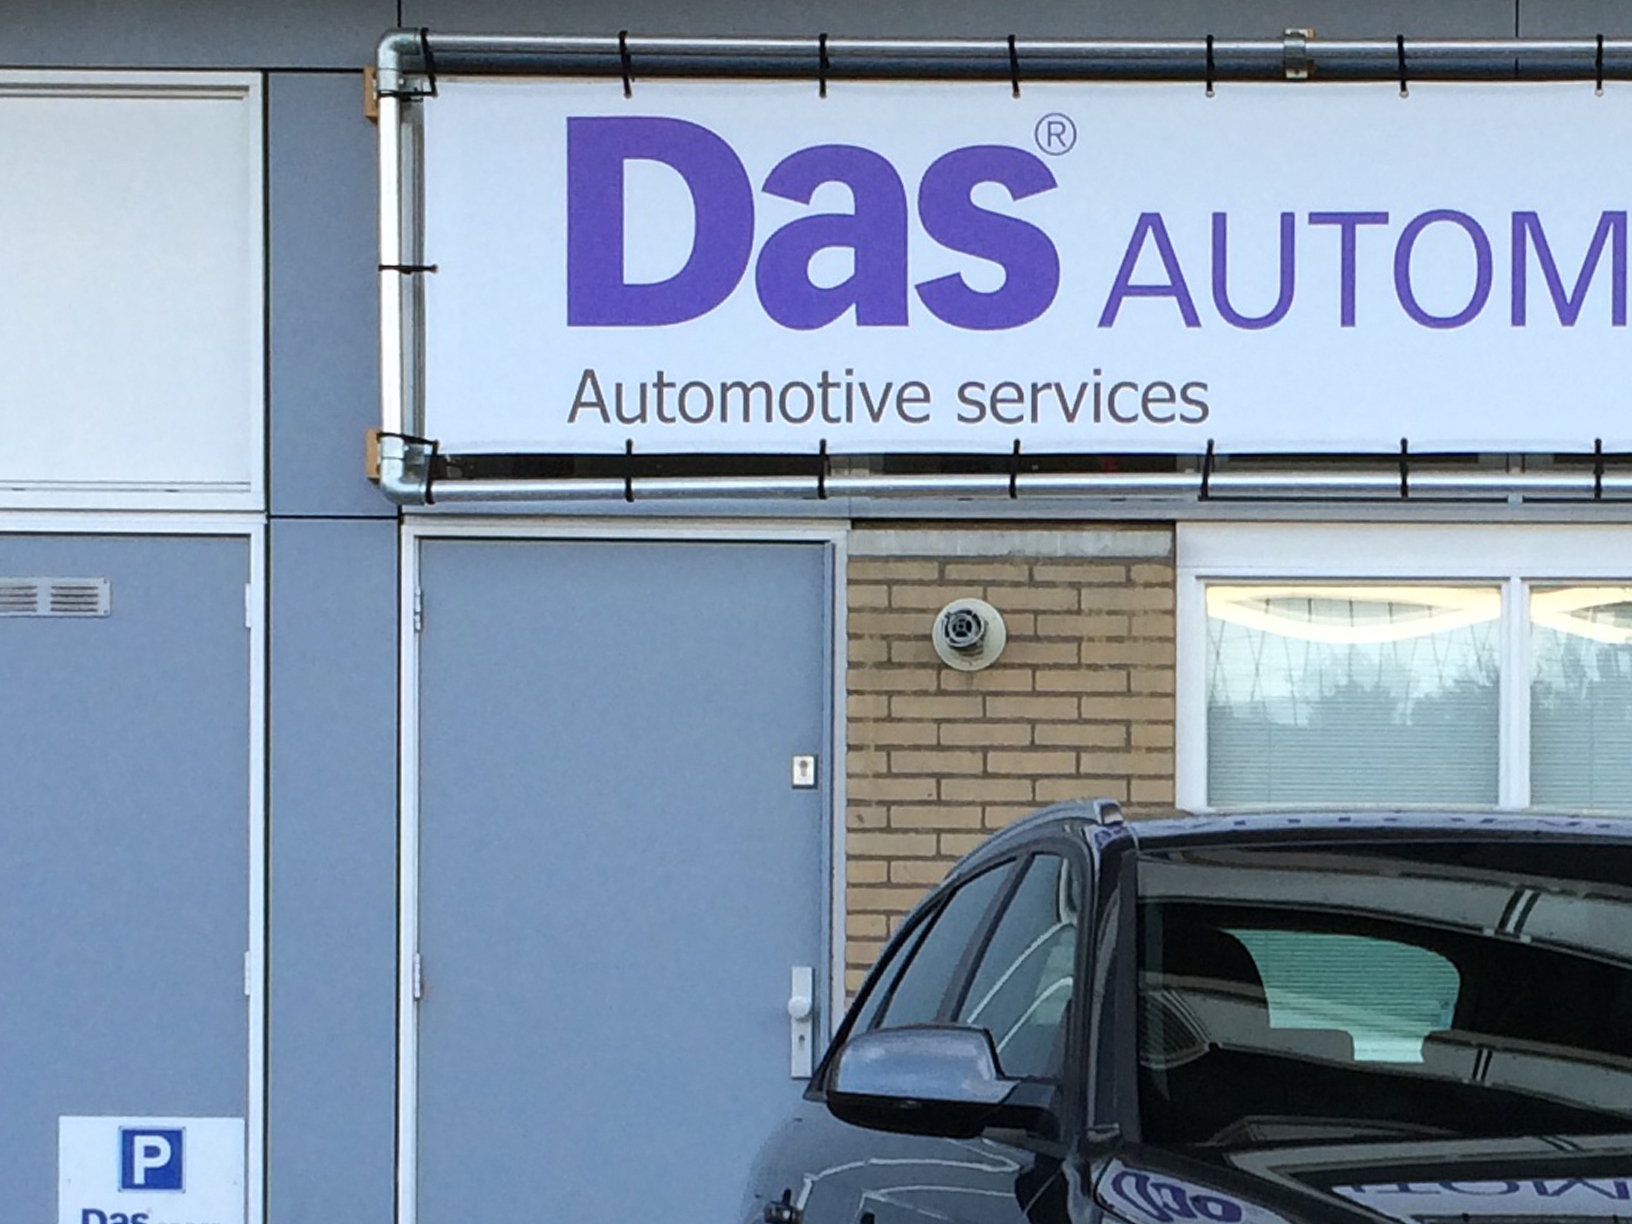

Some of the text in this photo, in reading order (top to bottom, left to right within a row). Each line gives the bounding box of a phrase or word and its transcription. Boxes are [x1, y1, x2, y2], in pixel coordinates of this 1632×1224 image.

[567, 368, 1210, 425] Automotive services
[133, 1134, 172, 1186] P
